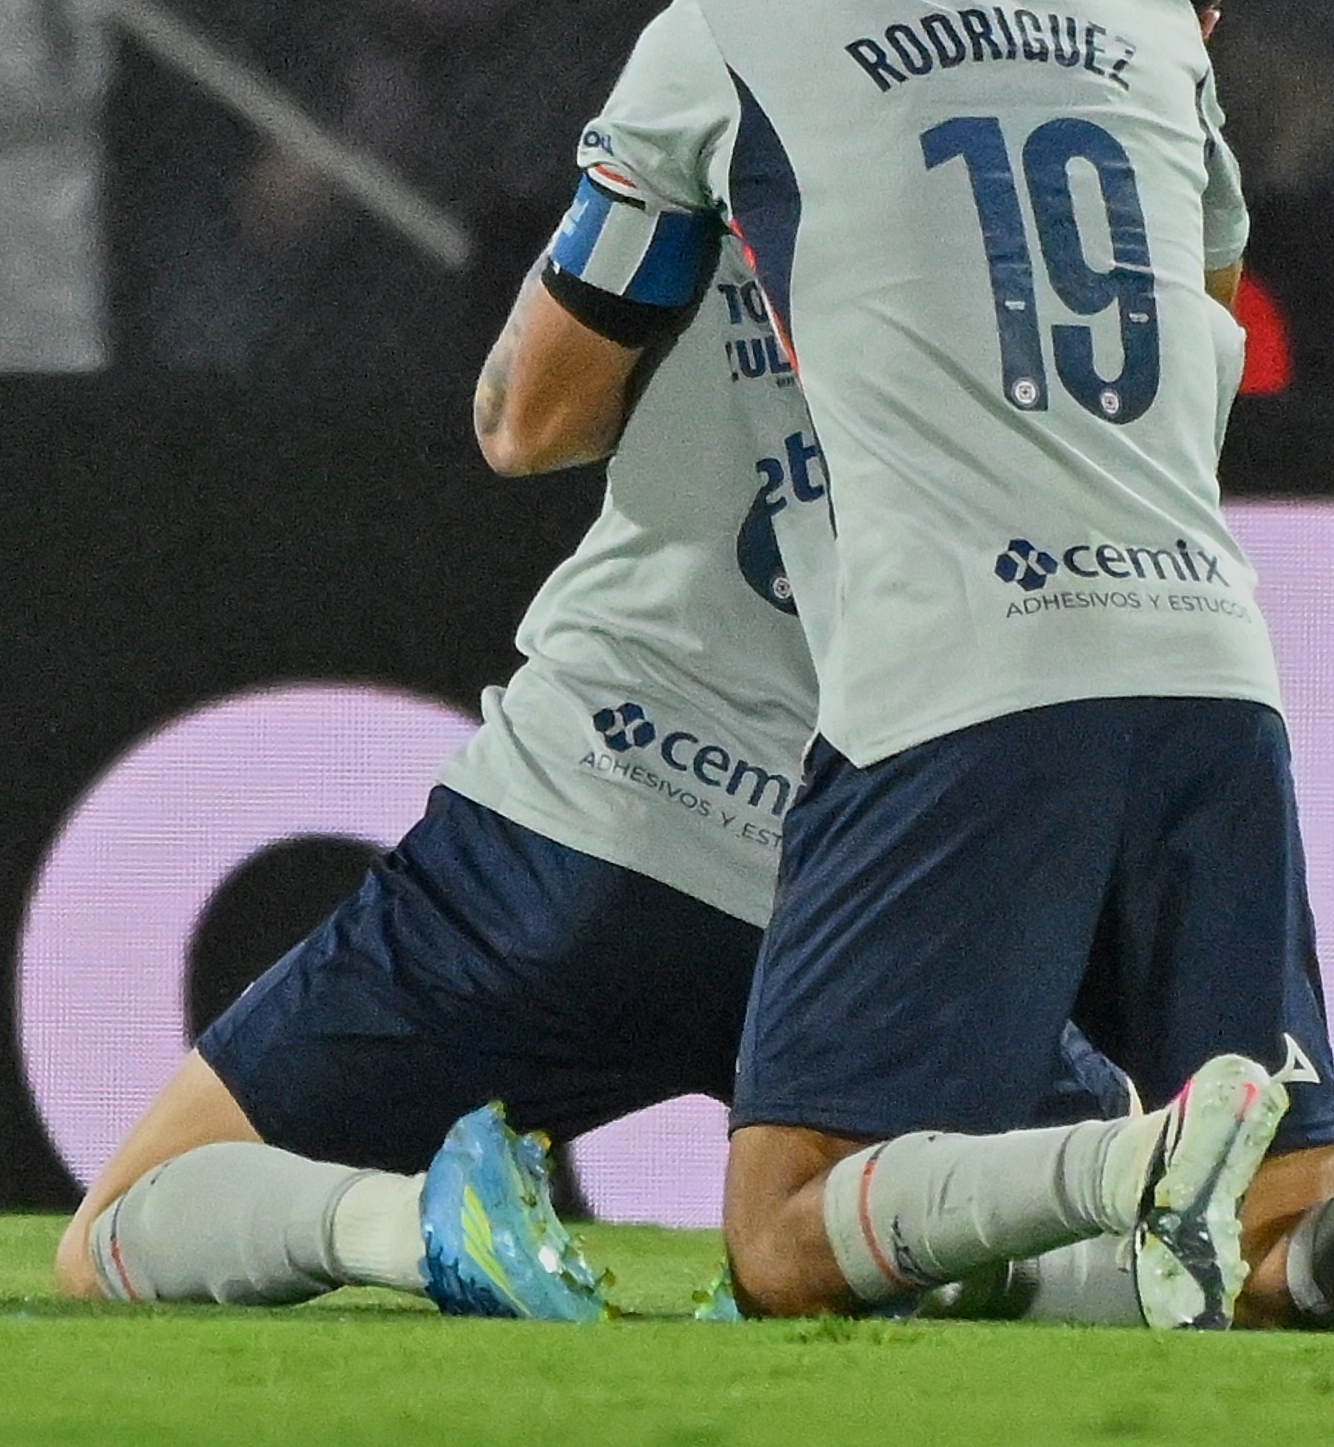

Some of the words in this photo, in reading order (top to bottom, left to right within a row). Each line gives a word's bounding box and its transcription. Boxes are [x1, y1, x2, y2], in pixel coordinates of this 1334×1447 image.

[844, 5, 1137, 93] RODRIGUEZ
[919, 115, 1161, 425] 19
[1062, 538, 1231, 588] cemix
[1005, 591, 1141, 619] ADHESIVOS
[1148, 593, 1160, 610] Y
[578, 751, 711, 817] ADHESIVOS
